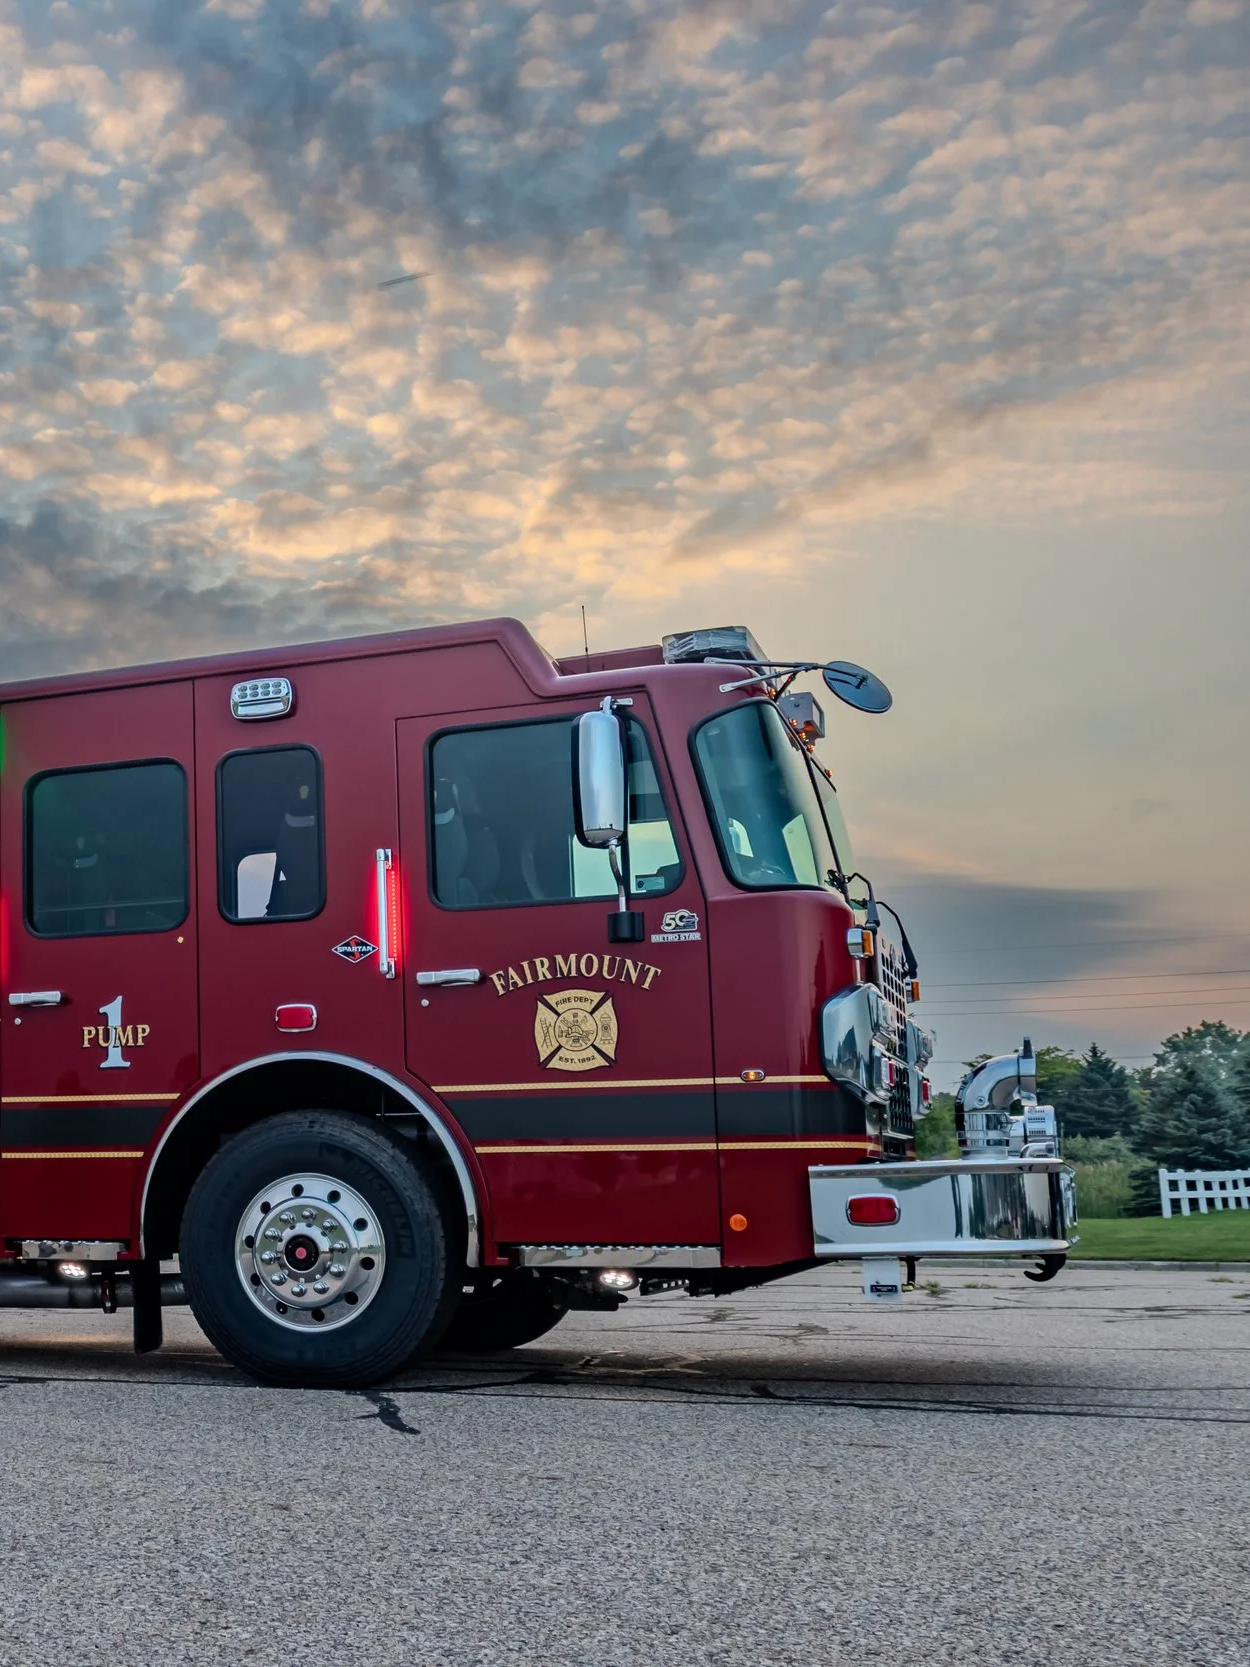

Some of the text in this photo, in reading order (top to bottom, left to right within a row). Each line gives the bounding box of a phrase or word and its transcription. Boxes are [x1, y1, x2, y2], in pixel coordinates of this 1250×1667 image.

[652, 933, 701, 943] METRO STAR
[336, 945, 373, 953] SPARTAN
[488, 953, 662, 997] FAIRMOUNT
[555, 996, 595, 1008] FIRE DEPT
[82, 1024, 151, 1048] PUMP
[98, 995, 131, 1068] 1
[558, 1055, 596, 1064] EST. 1892
[350, 1159, 411, 1254] MICHELIN
